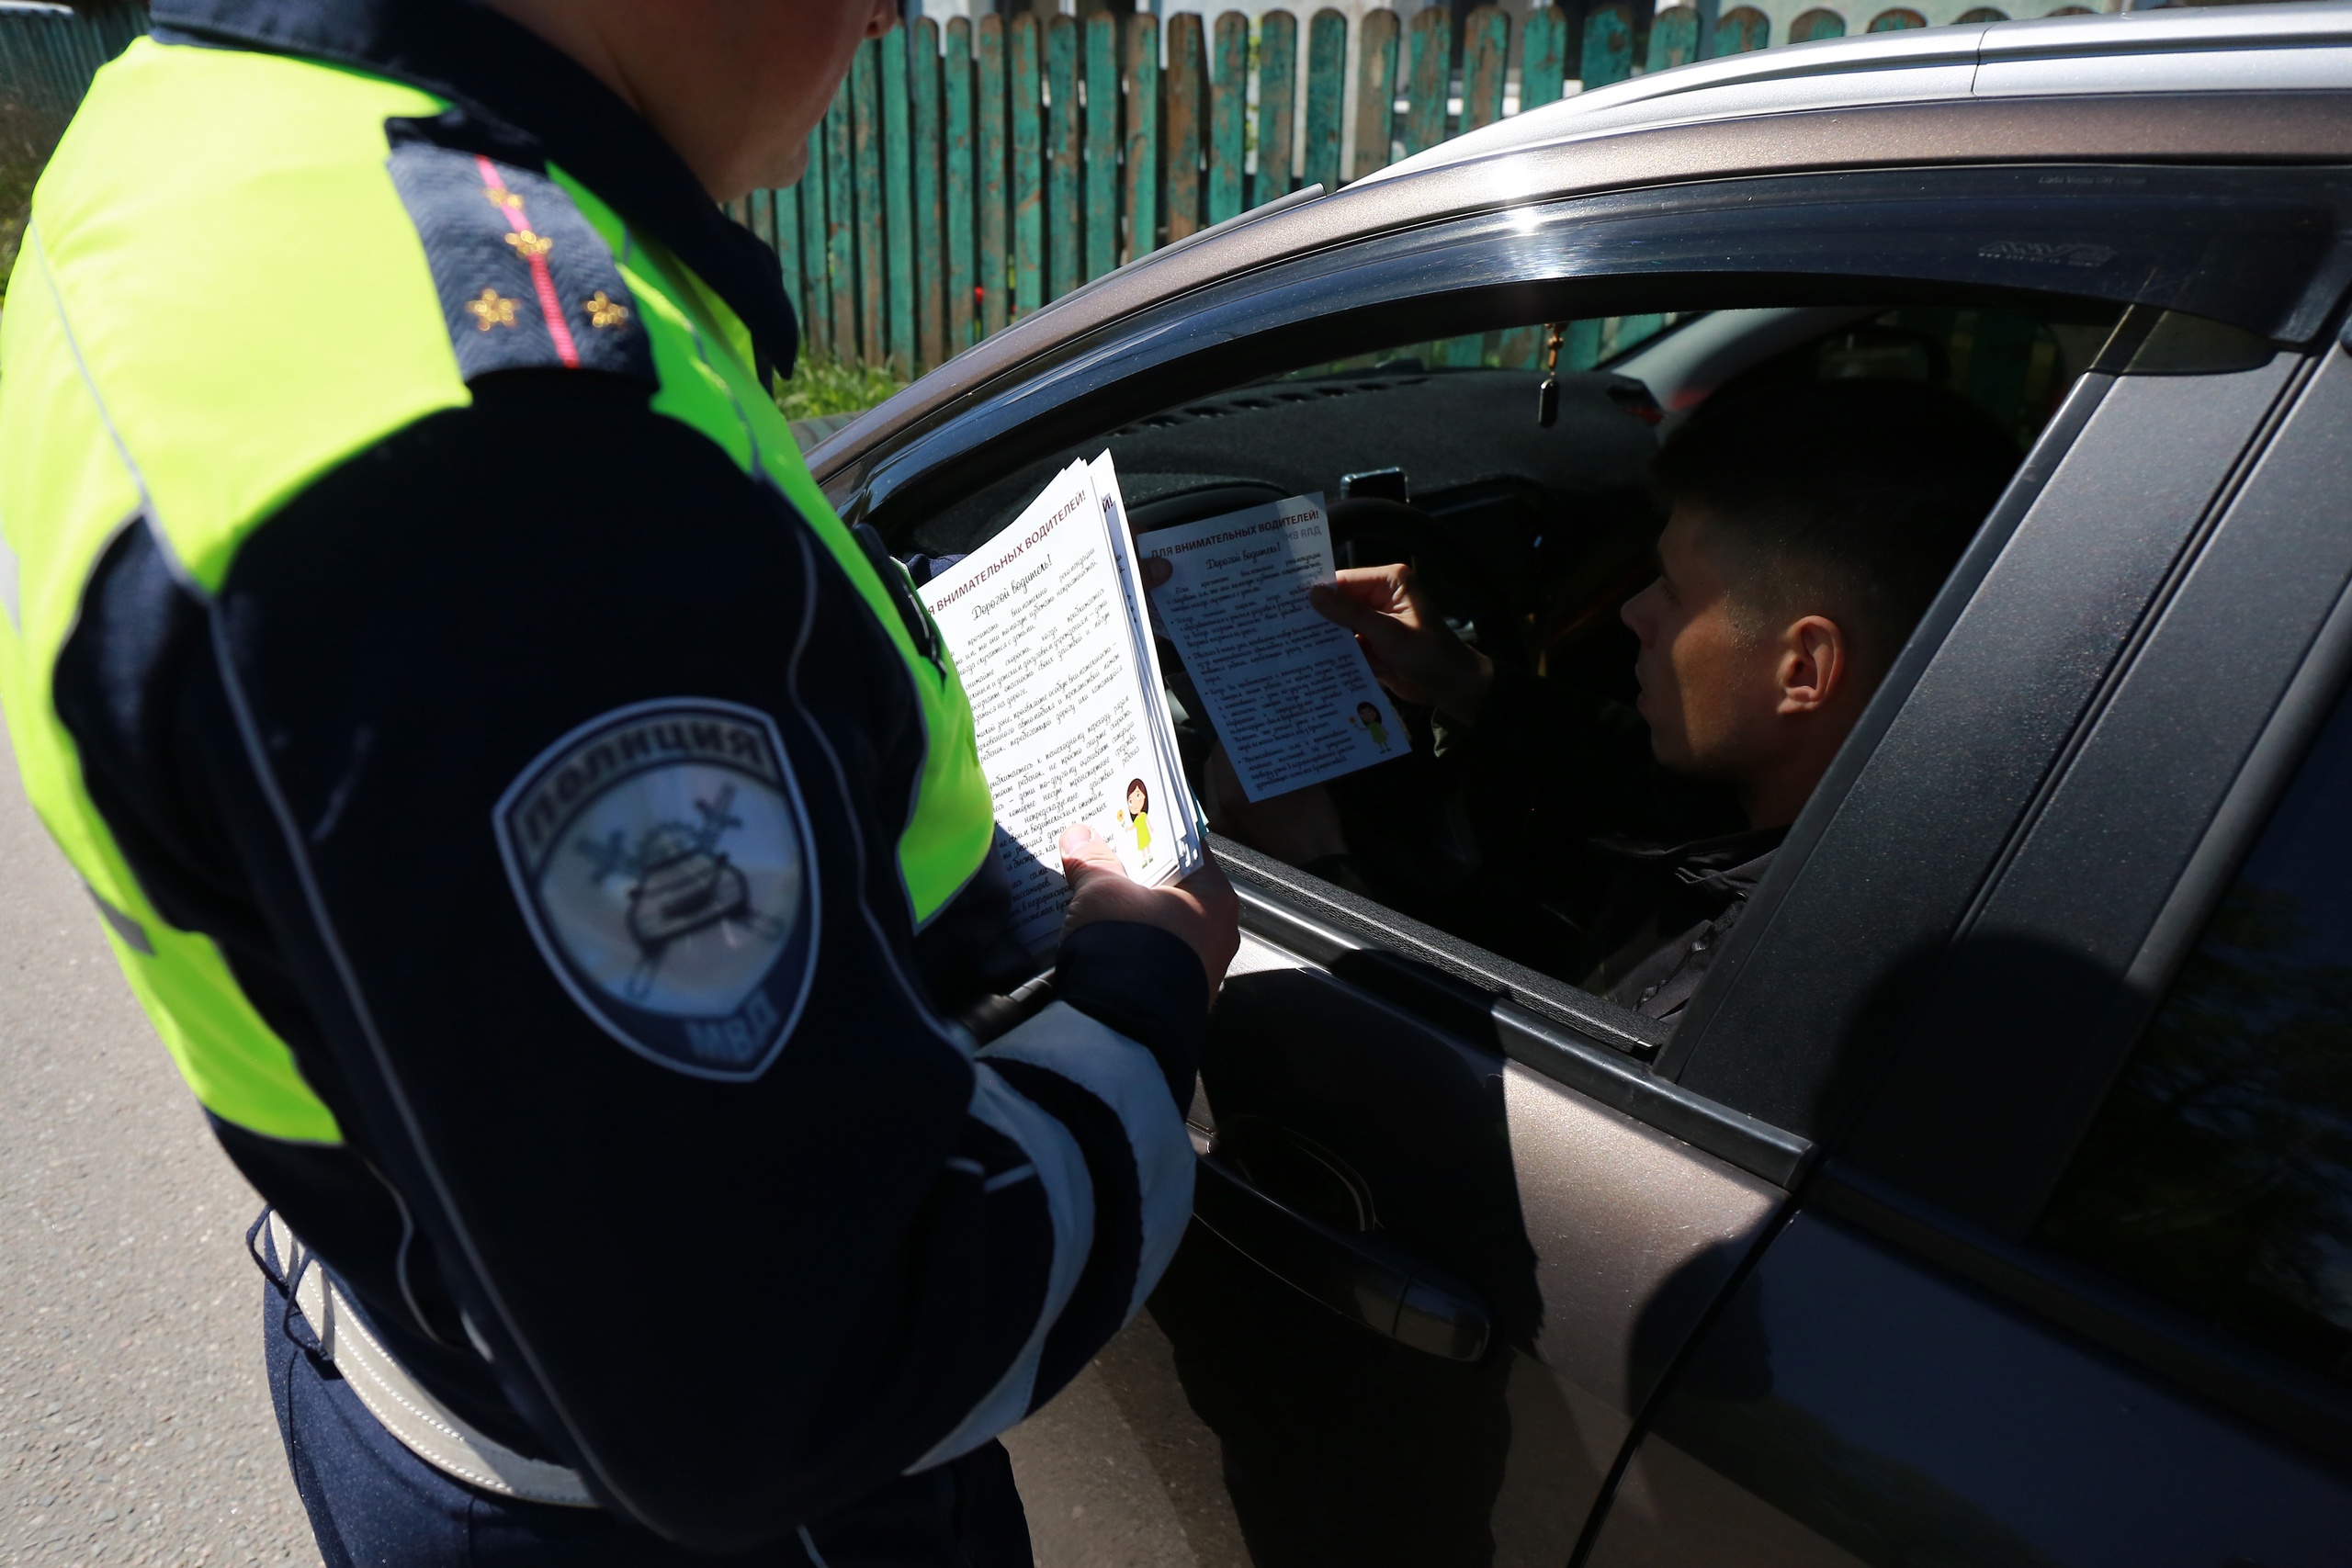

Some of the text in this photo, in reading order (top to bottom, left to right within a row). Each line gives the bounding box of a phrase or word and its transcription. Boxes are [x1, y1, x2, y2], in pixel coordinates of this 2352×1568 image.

[936, 490, 1086, 612] ВНИМАТЕЛЬНЫХ ВОДИТЕЛЕЙ!
[1151, 509, 1319, 558] ДЛЯ ВНИМАТЕЛЬНЫХ ВОДИТЕЛЕЙ!
[1205, 552, 1242, 570] Дорогой
[971, 553, 1052, 621] Дорогой водитель!
[958, 662, 976, 677] ногда
[524, 721, 766, 845] ПОЛИЦИЯ
[685, 988, 779, 1061] МВД
